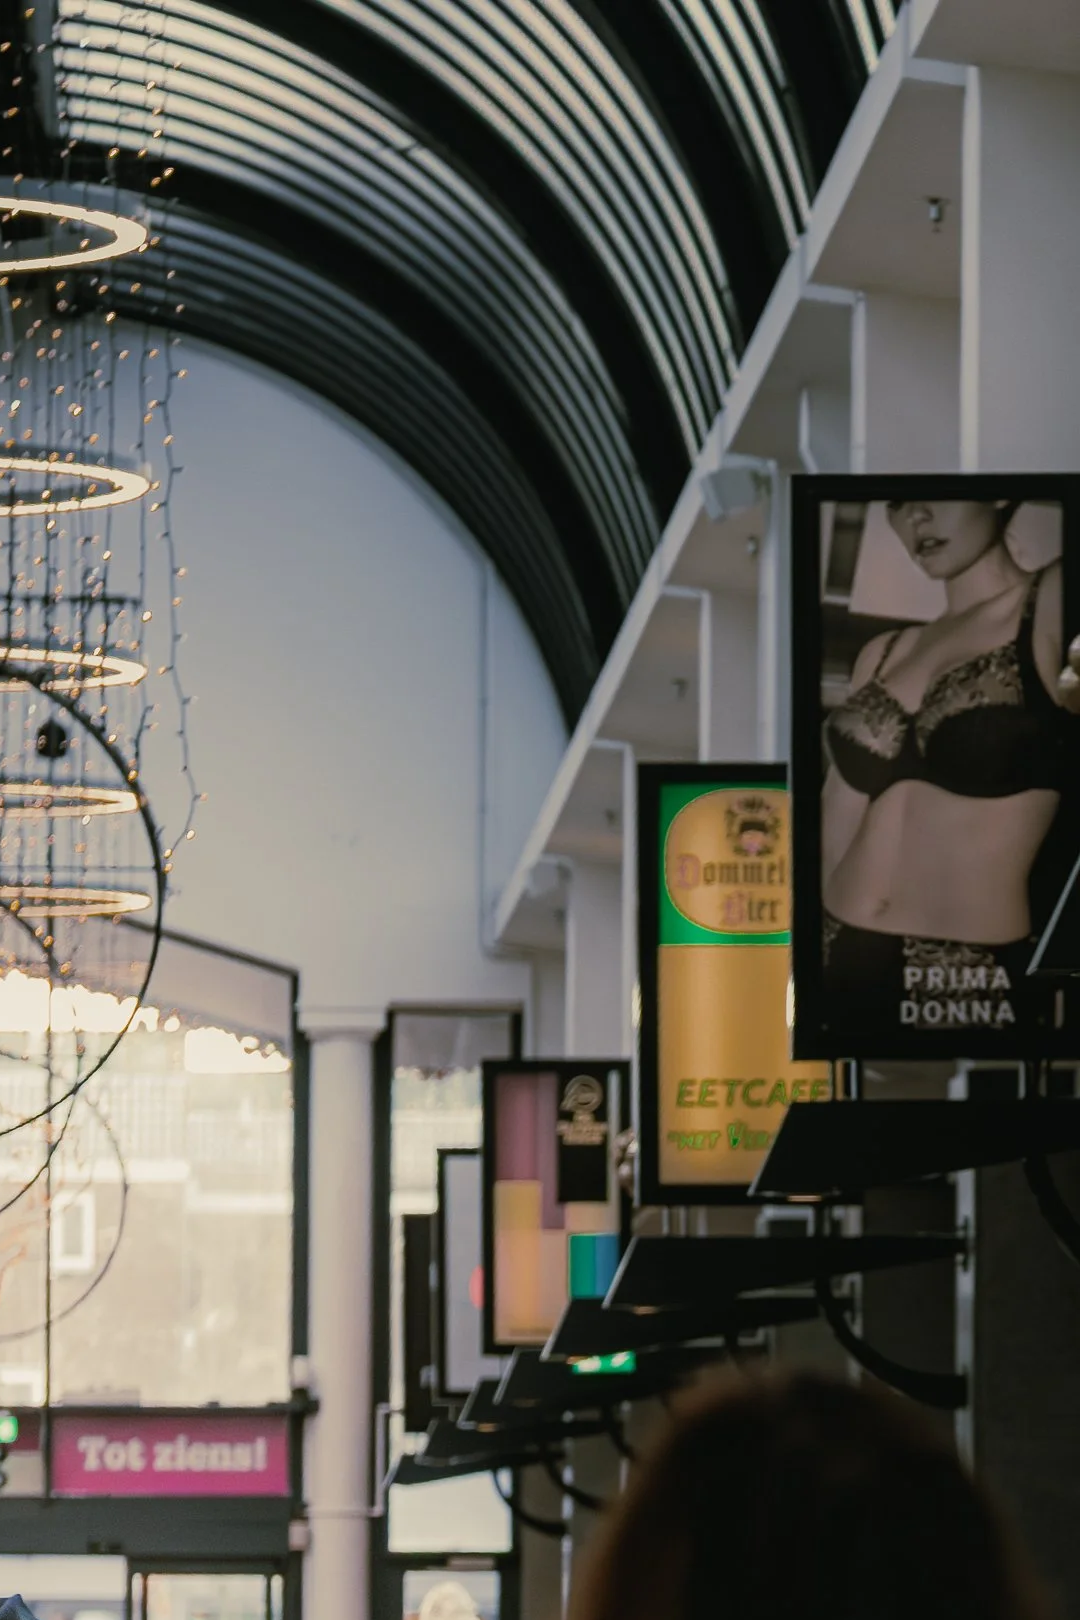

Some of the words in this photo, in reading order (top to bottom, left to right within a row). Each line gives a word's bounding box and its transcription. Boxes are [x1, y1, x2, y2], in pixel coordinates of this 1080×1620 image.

[902, 965, 1012, 990] PRIMA
[899, 1000, 1016, 1024] DONNA
[77, 1434, 145, 1472] Tot
[152, 1433, 268, 1472] ziens!
